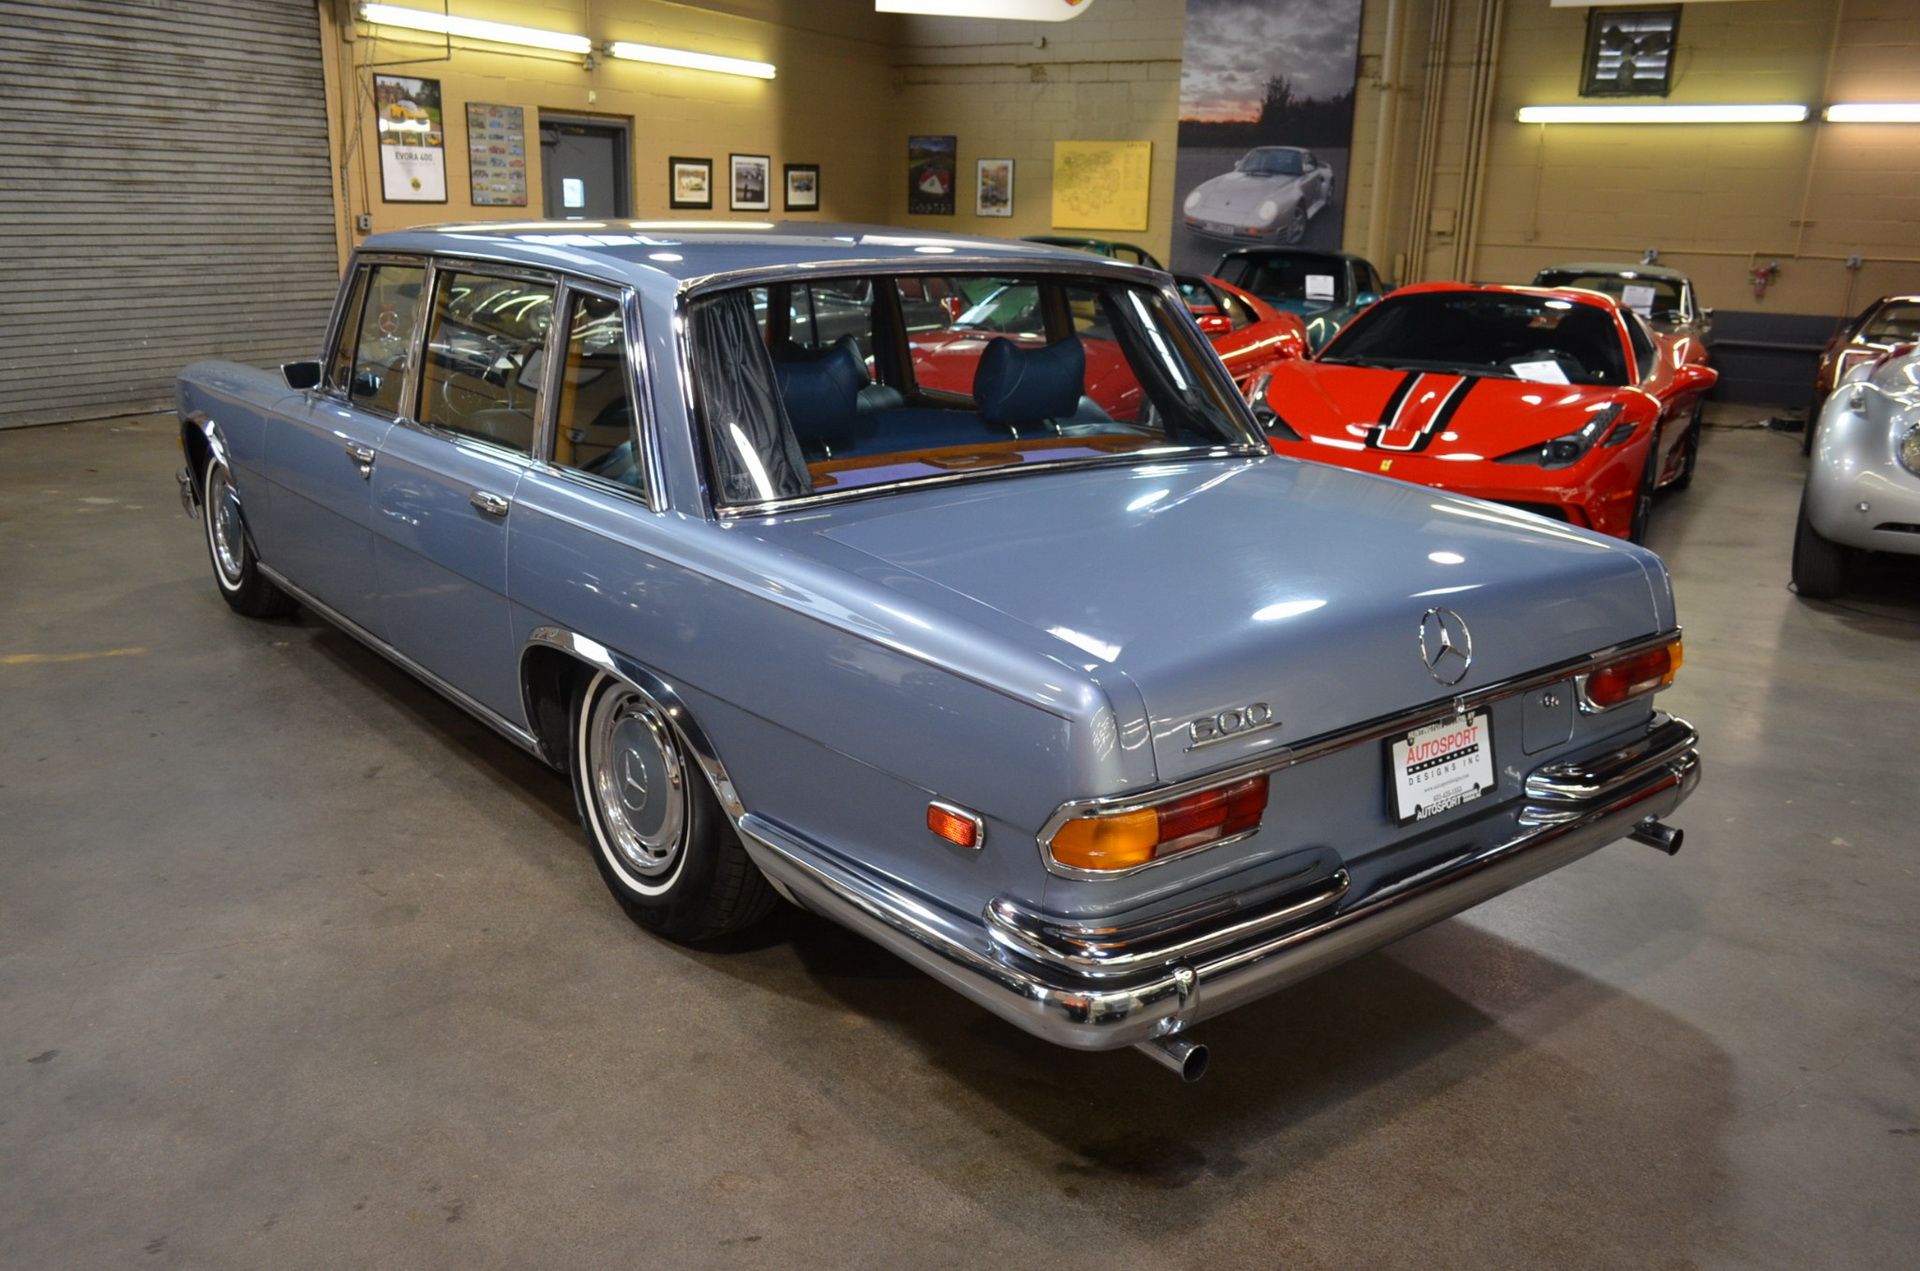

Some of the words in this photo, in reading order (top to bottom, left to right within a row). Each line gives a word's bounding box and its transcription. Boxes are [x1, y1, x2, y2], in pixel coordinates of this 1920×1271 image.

[395, 151, 418, 160] EVORA
[1189, 702, 1272, 744] 600
[1407, 726, 1478, 764] AUTOSPORT
[1408, 762, 1456, 786] DESIGNS
[1463, 753, 1480, 767] INC
[1416, 796, 1462, 821] AUTOSPORT
